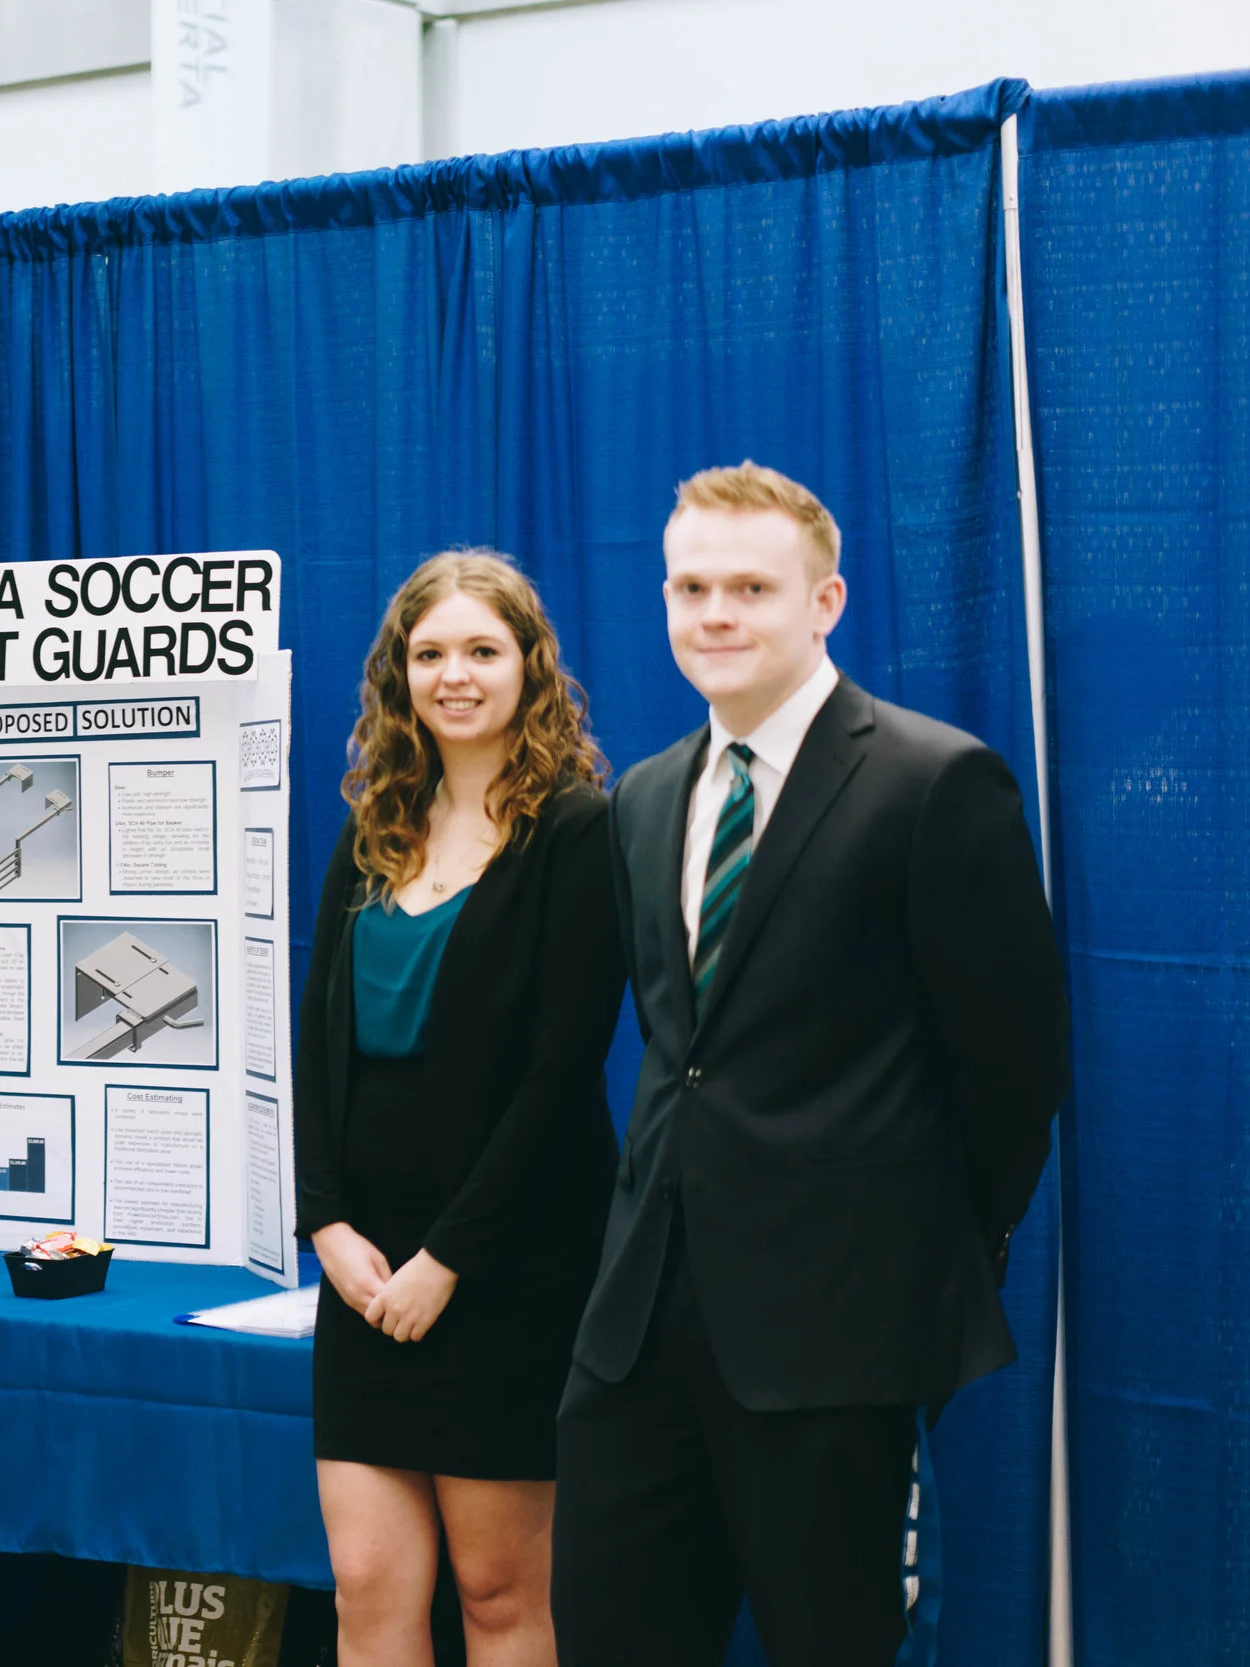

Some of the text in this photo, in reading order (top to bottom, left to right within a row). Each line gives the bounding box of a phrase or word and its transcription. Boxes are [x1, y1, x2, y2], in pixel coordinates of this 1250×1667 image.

[45, 556, 273, 619] SOCCER
[32, 619, 255, 683] GUARDS
[81, 704, 192, 731] SOLUTION
[147, 769, 175, 778] Bumper
[127, 1092, 183, 1103] Cost Estimating
